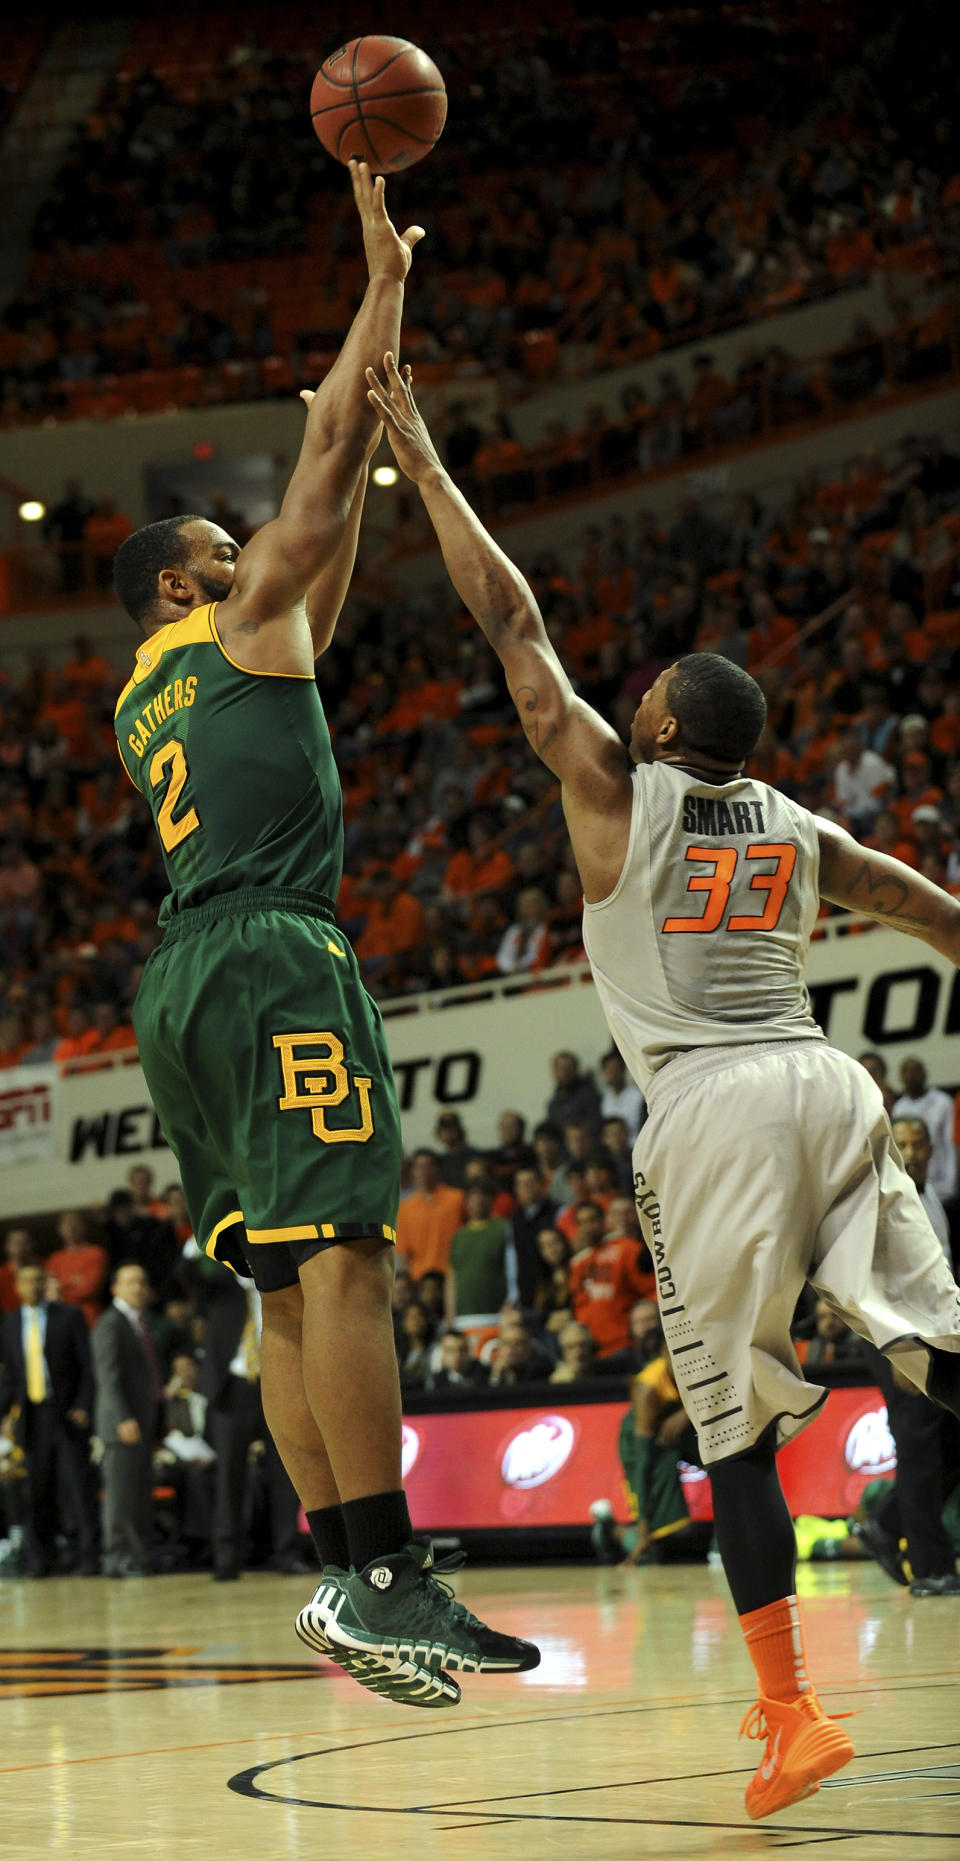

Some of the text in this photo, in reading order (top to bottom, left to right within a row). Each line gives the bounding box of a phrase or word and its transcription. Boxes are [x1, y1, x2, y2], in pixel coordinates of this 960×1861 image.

[128, 675, 198, 758] GATHERS
[149, 737, 201, 854] 2
[682, 795, 767, 837] SMART
[661, 843, 797, 934] 33
[68, 1050, 482, 1165] WEL TO
[272, 1031, 374, 1144] BU
[634, 1171, 677, 1300] COWBOYS
